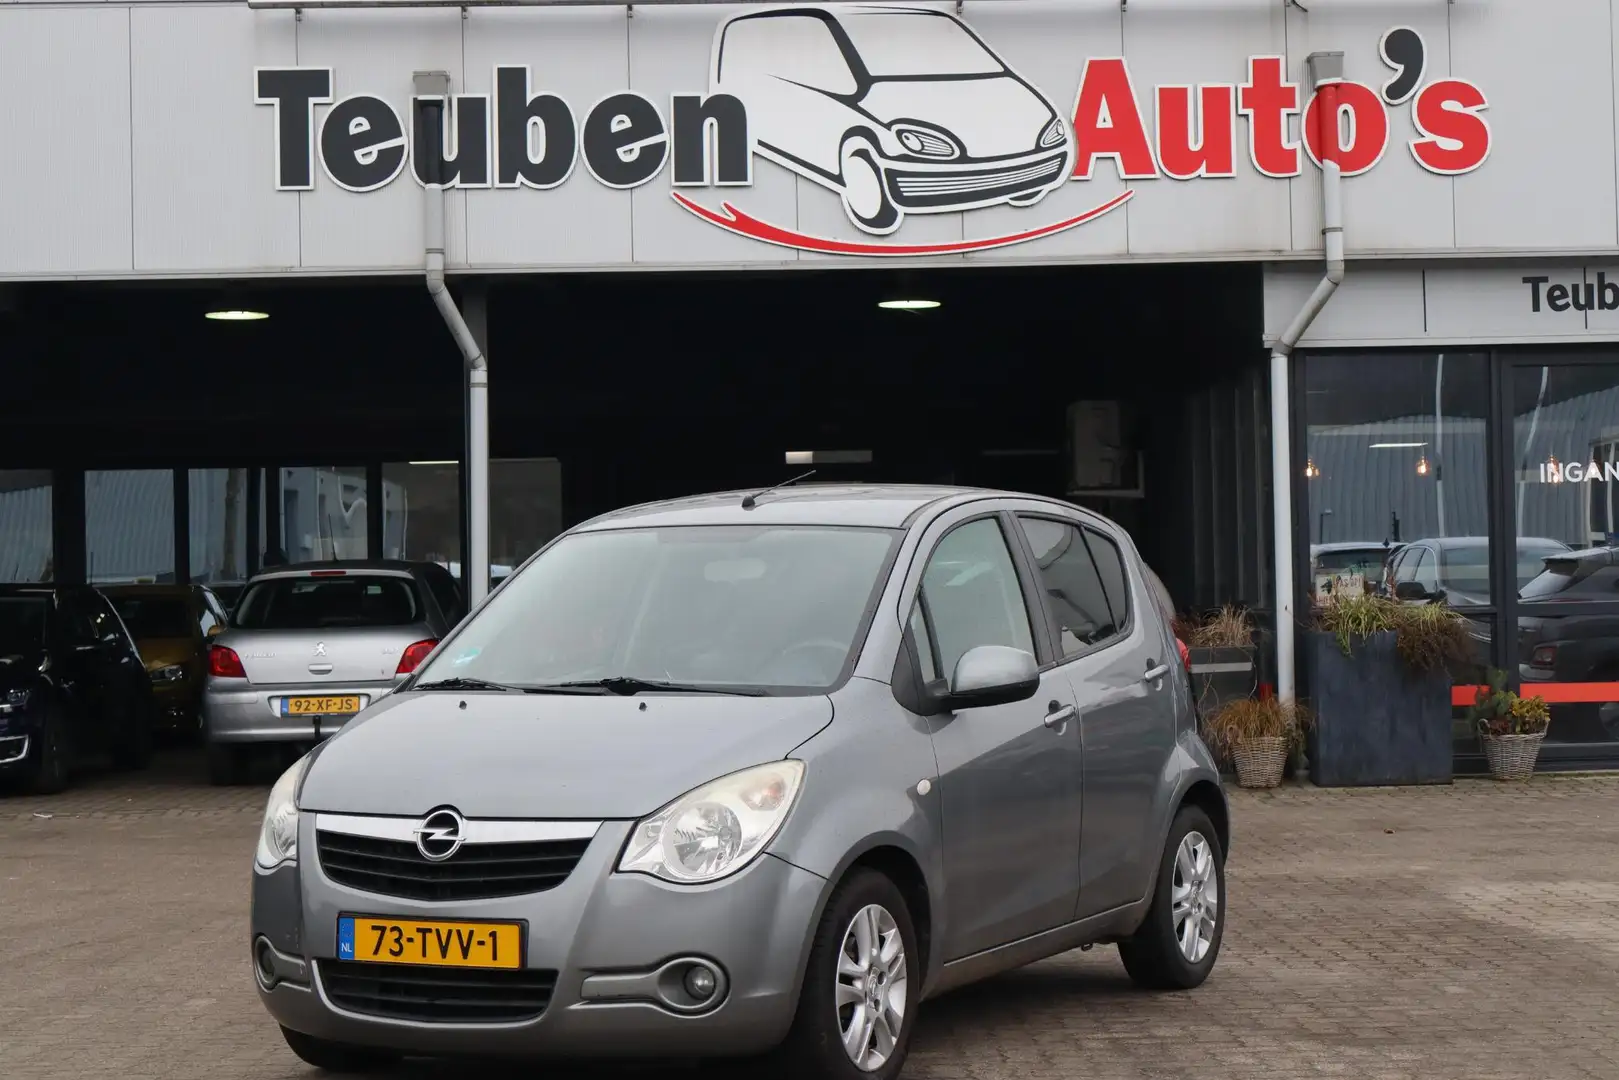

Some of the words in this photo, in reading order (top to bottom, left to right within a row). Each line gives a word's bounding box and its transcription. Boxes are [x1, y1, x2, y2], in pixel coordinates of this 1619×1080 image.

[255, 65, 752, 191] Teuben
[1071, 26, 1491, 180] Auto's
[1522, 271, 1619, 312] Teub
[1540, 461, 1619, 483] INGAN
[294, 698, 353, 711] 92-XF-JS
[341, 942, 352, 953] NL
[371, 925, 498, 961] 73-TVV-1
